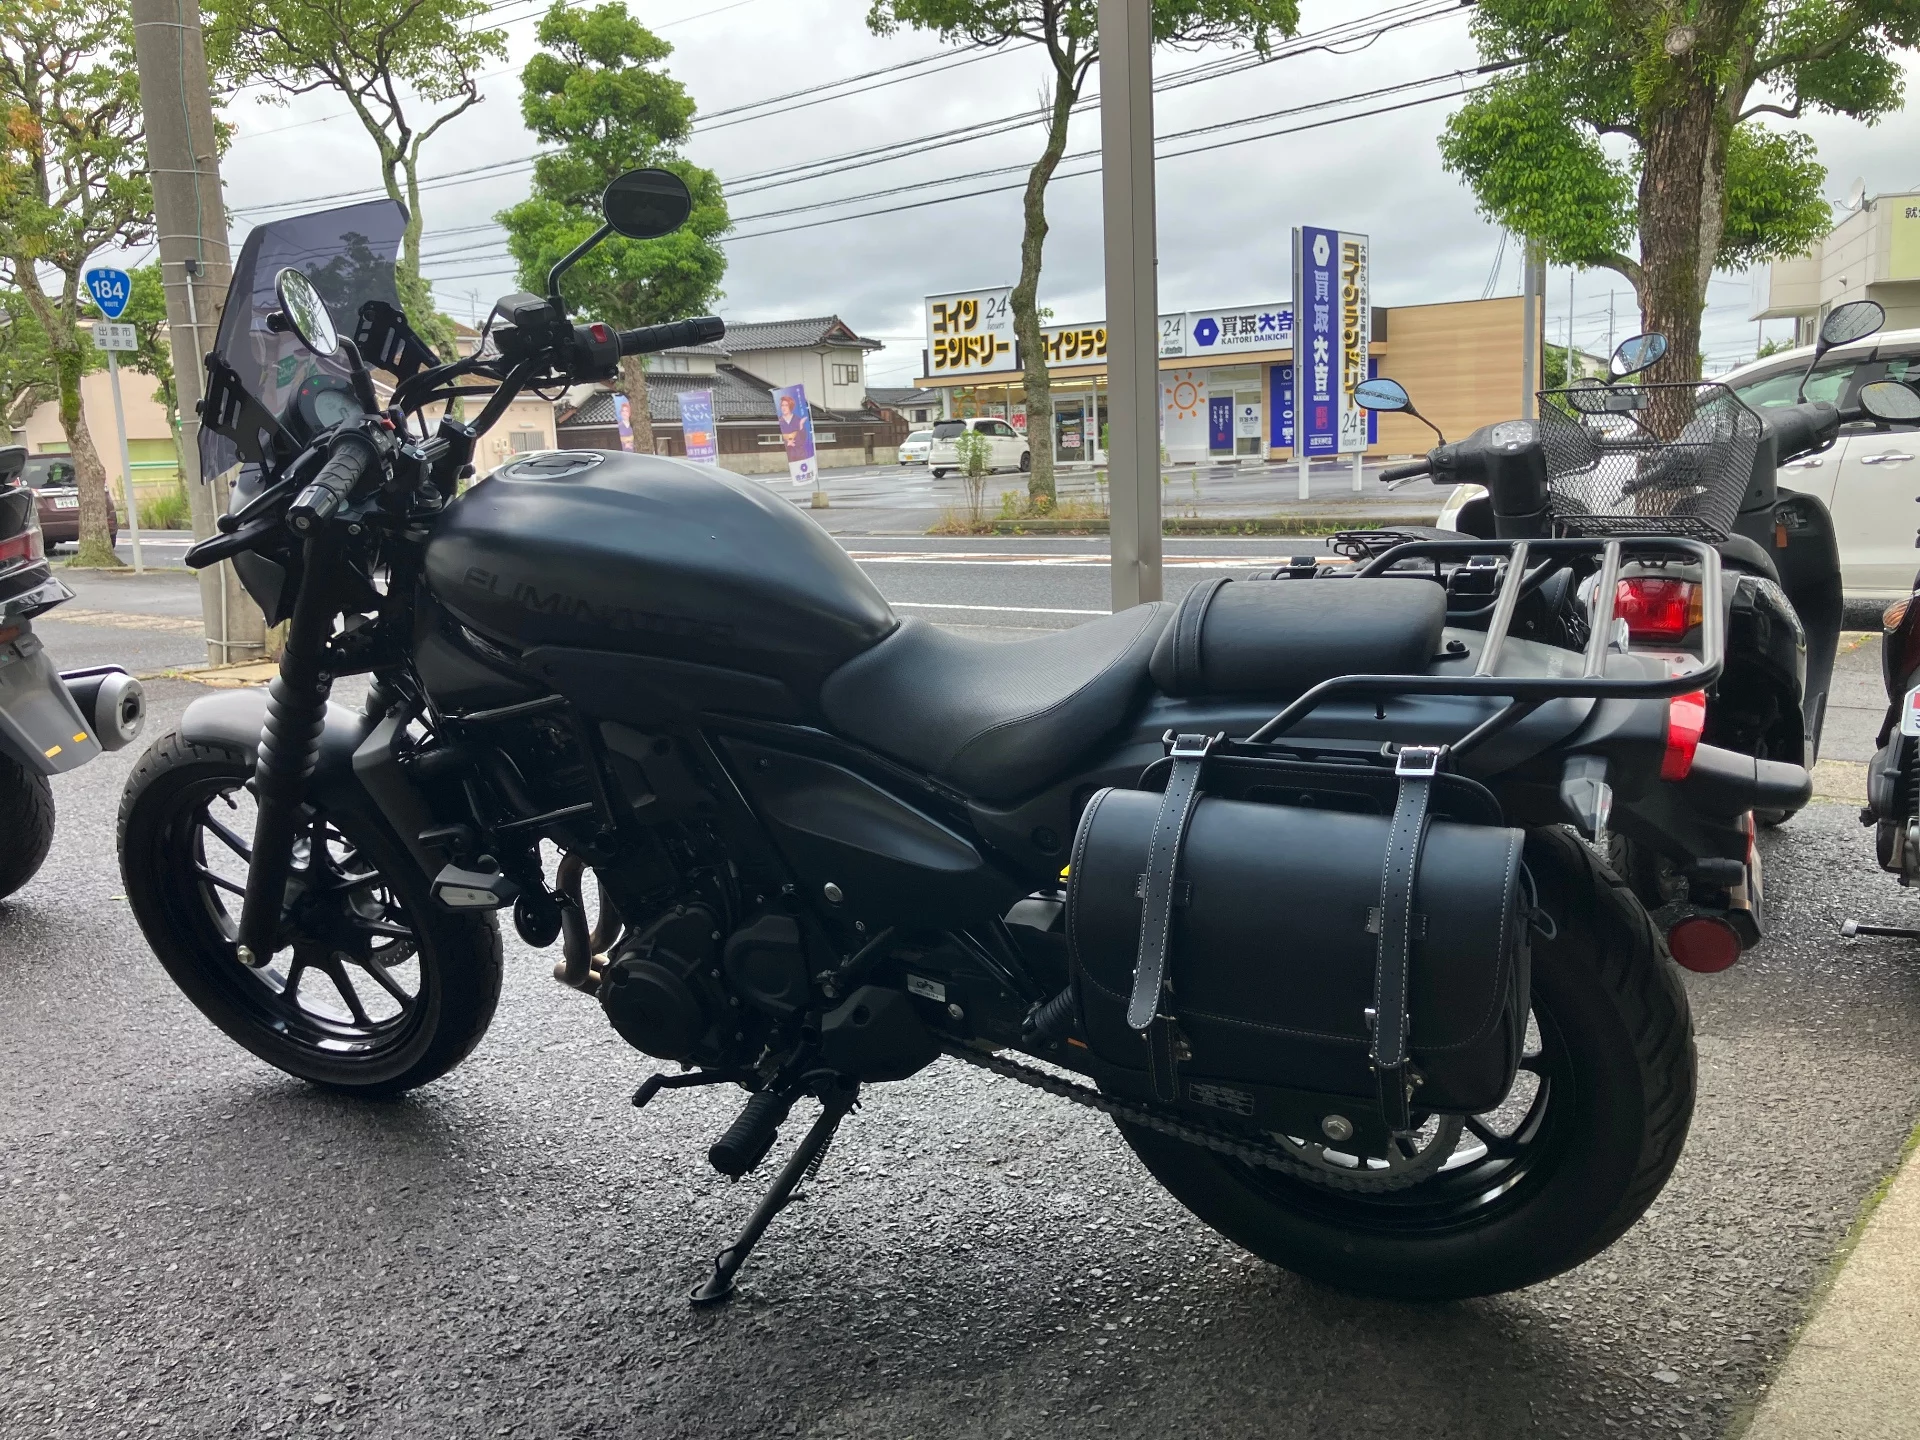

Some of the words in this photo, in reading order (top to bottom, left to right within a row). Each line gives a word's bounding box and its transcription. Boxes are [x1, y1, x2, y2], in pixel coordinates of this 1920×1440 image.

[92, 280, 124, 299] 184
[932, 300, 978, 334] コイン
[986, 295, 1007, 319] 24
[98, 326, 131, 337] 出雲市
[1163, 318, 1181, 337] 24
[1221, 311, 1293, 337] 買取大吉
[1313, 270, 1329, 391] 買取大吉
[1342, 241, 1360, 410] コインランドリー
[1221, 334, 1252, 345] KAITORI
[1254, 332, 1288, 342] DAIKICHI
[934, 334, 1010, 369] ランドリー
[1341, 412, 1358, 433] 24
